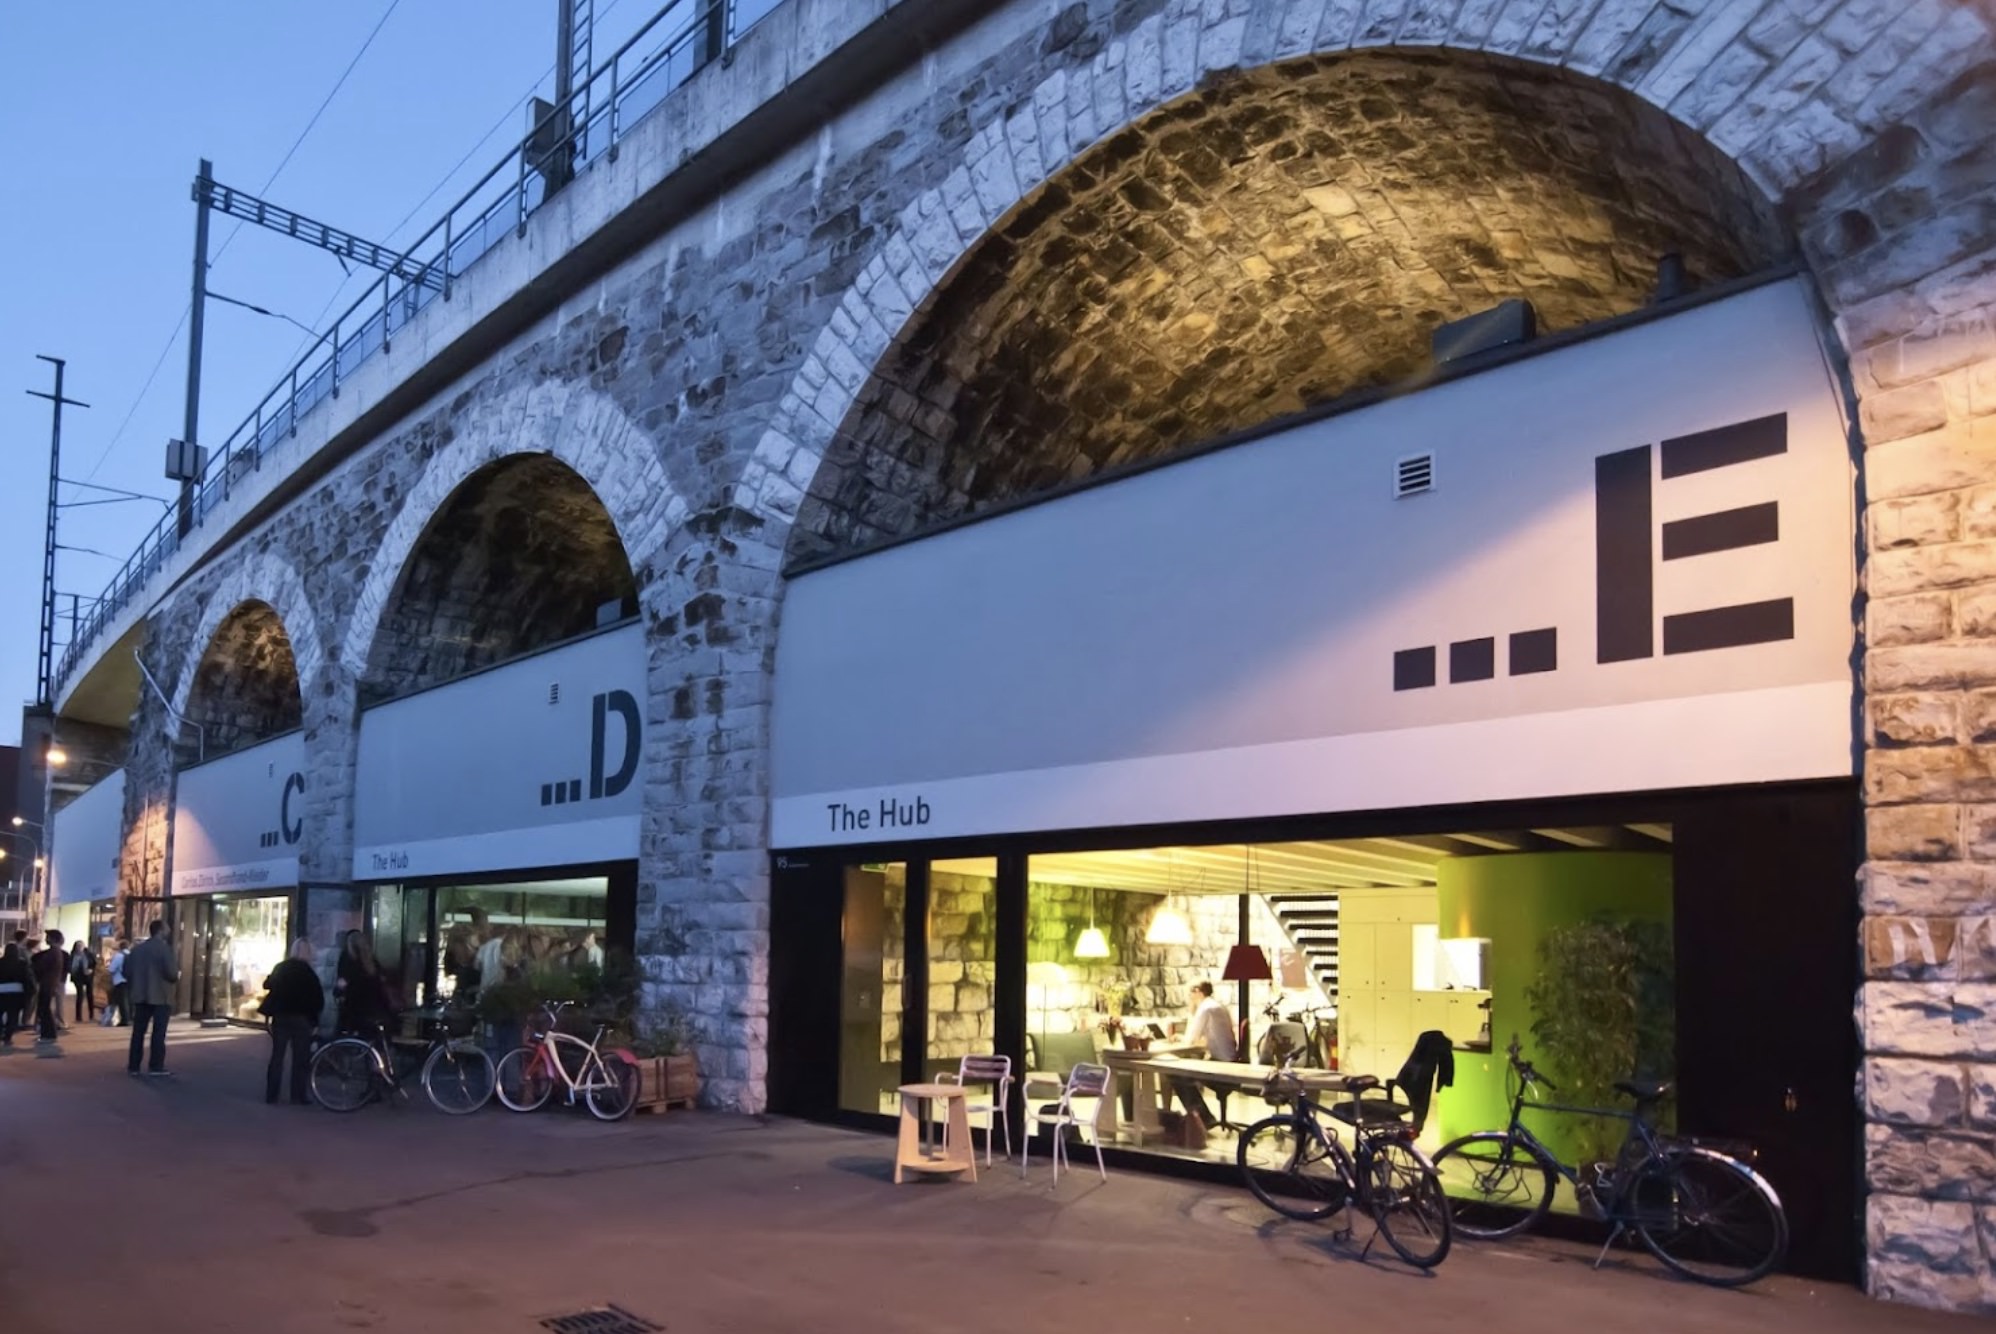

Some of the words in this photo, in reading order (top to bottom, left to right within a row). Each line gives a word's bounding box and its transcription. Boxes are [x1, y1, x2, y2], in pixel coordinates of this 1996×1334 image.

[827, 803, 870, 832] The
[879, 795, 930, 828] Hub
[372, 853, 388, 871] The
[390, 850, 409, 869] Hub
